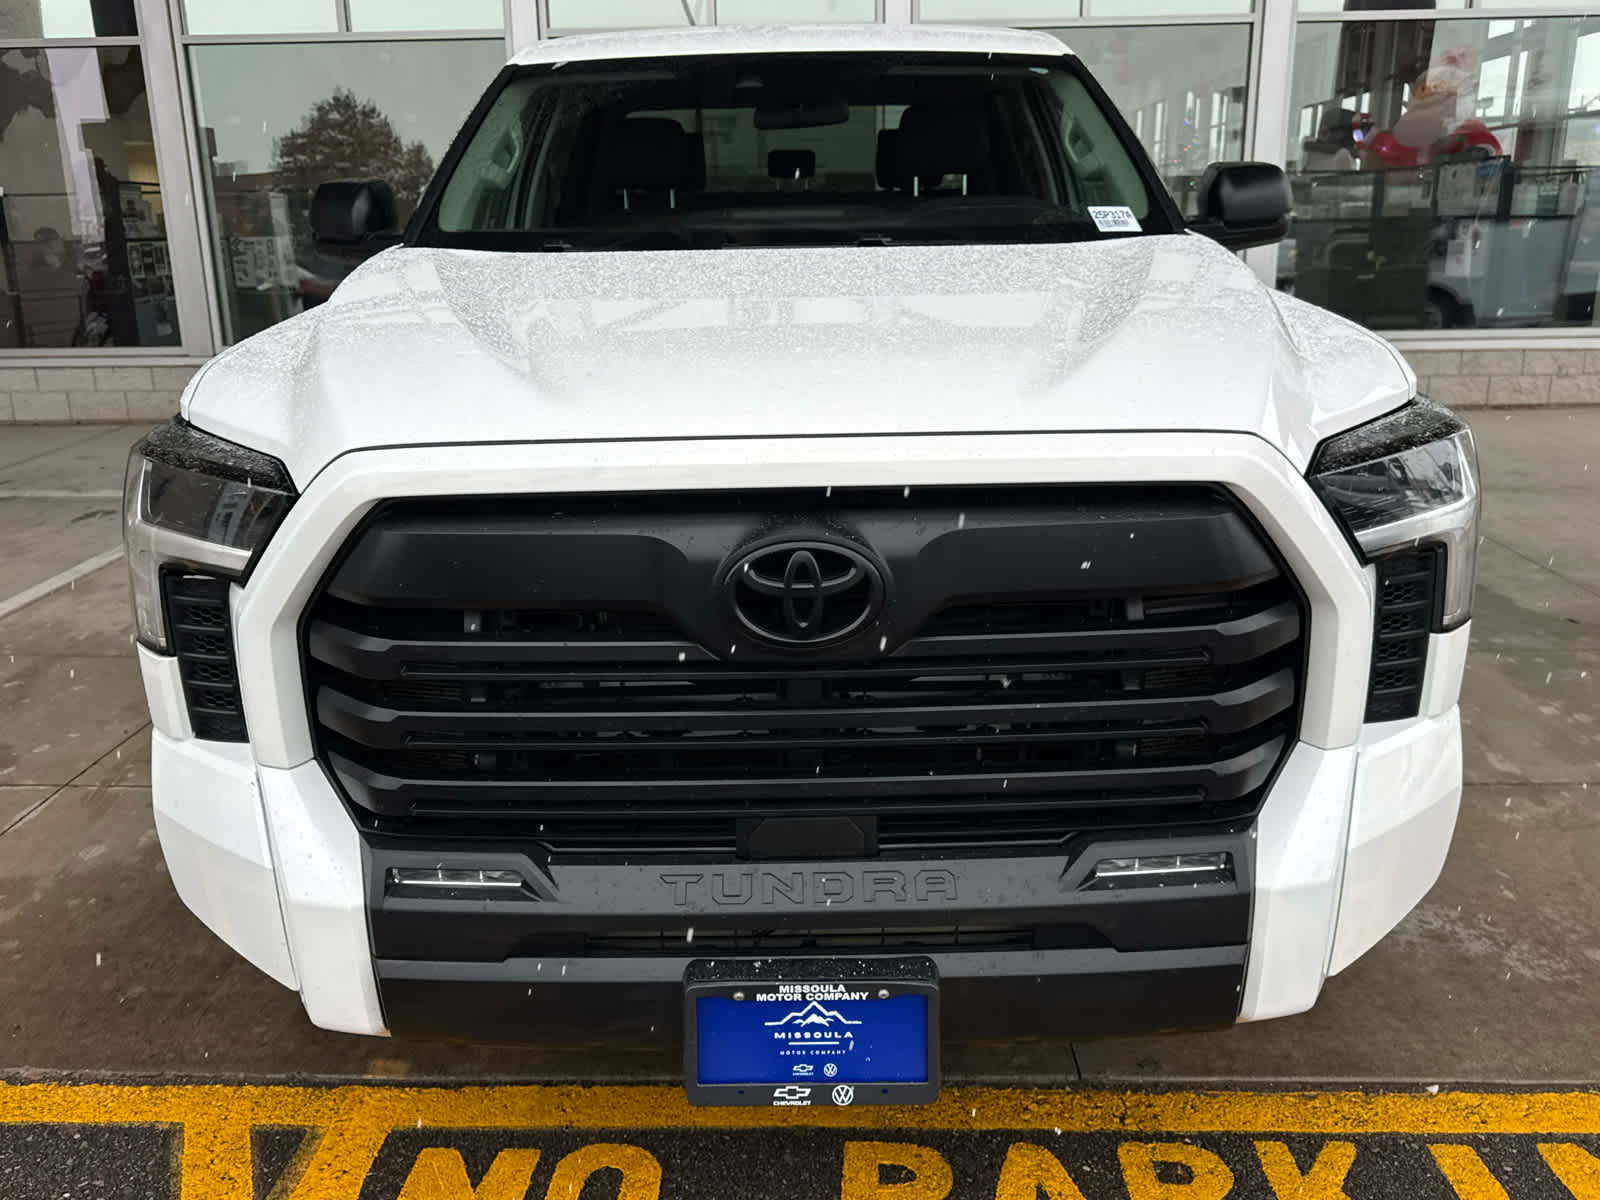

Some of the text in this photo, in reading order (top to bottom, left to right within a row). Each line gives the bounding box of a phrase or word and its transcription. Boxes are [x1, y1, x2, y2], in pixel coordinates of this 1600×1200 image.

[659, 869, 958, 906] TUNDRA
[779, 984, 846, 993] MISSOULA
[756, 992, 869, 1002] MOTOR COMPANY
[774, 1031, 853, 1040] MISSOULA
